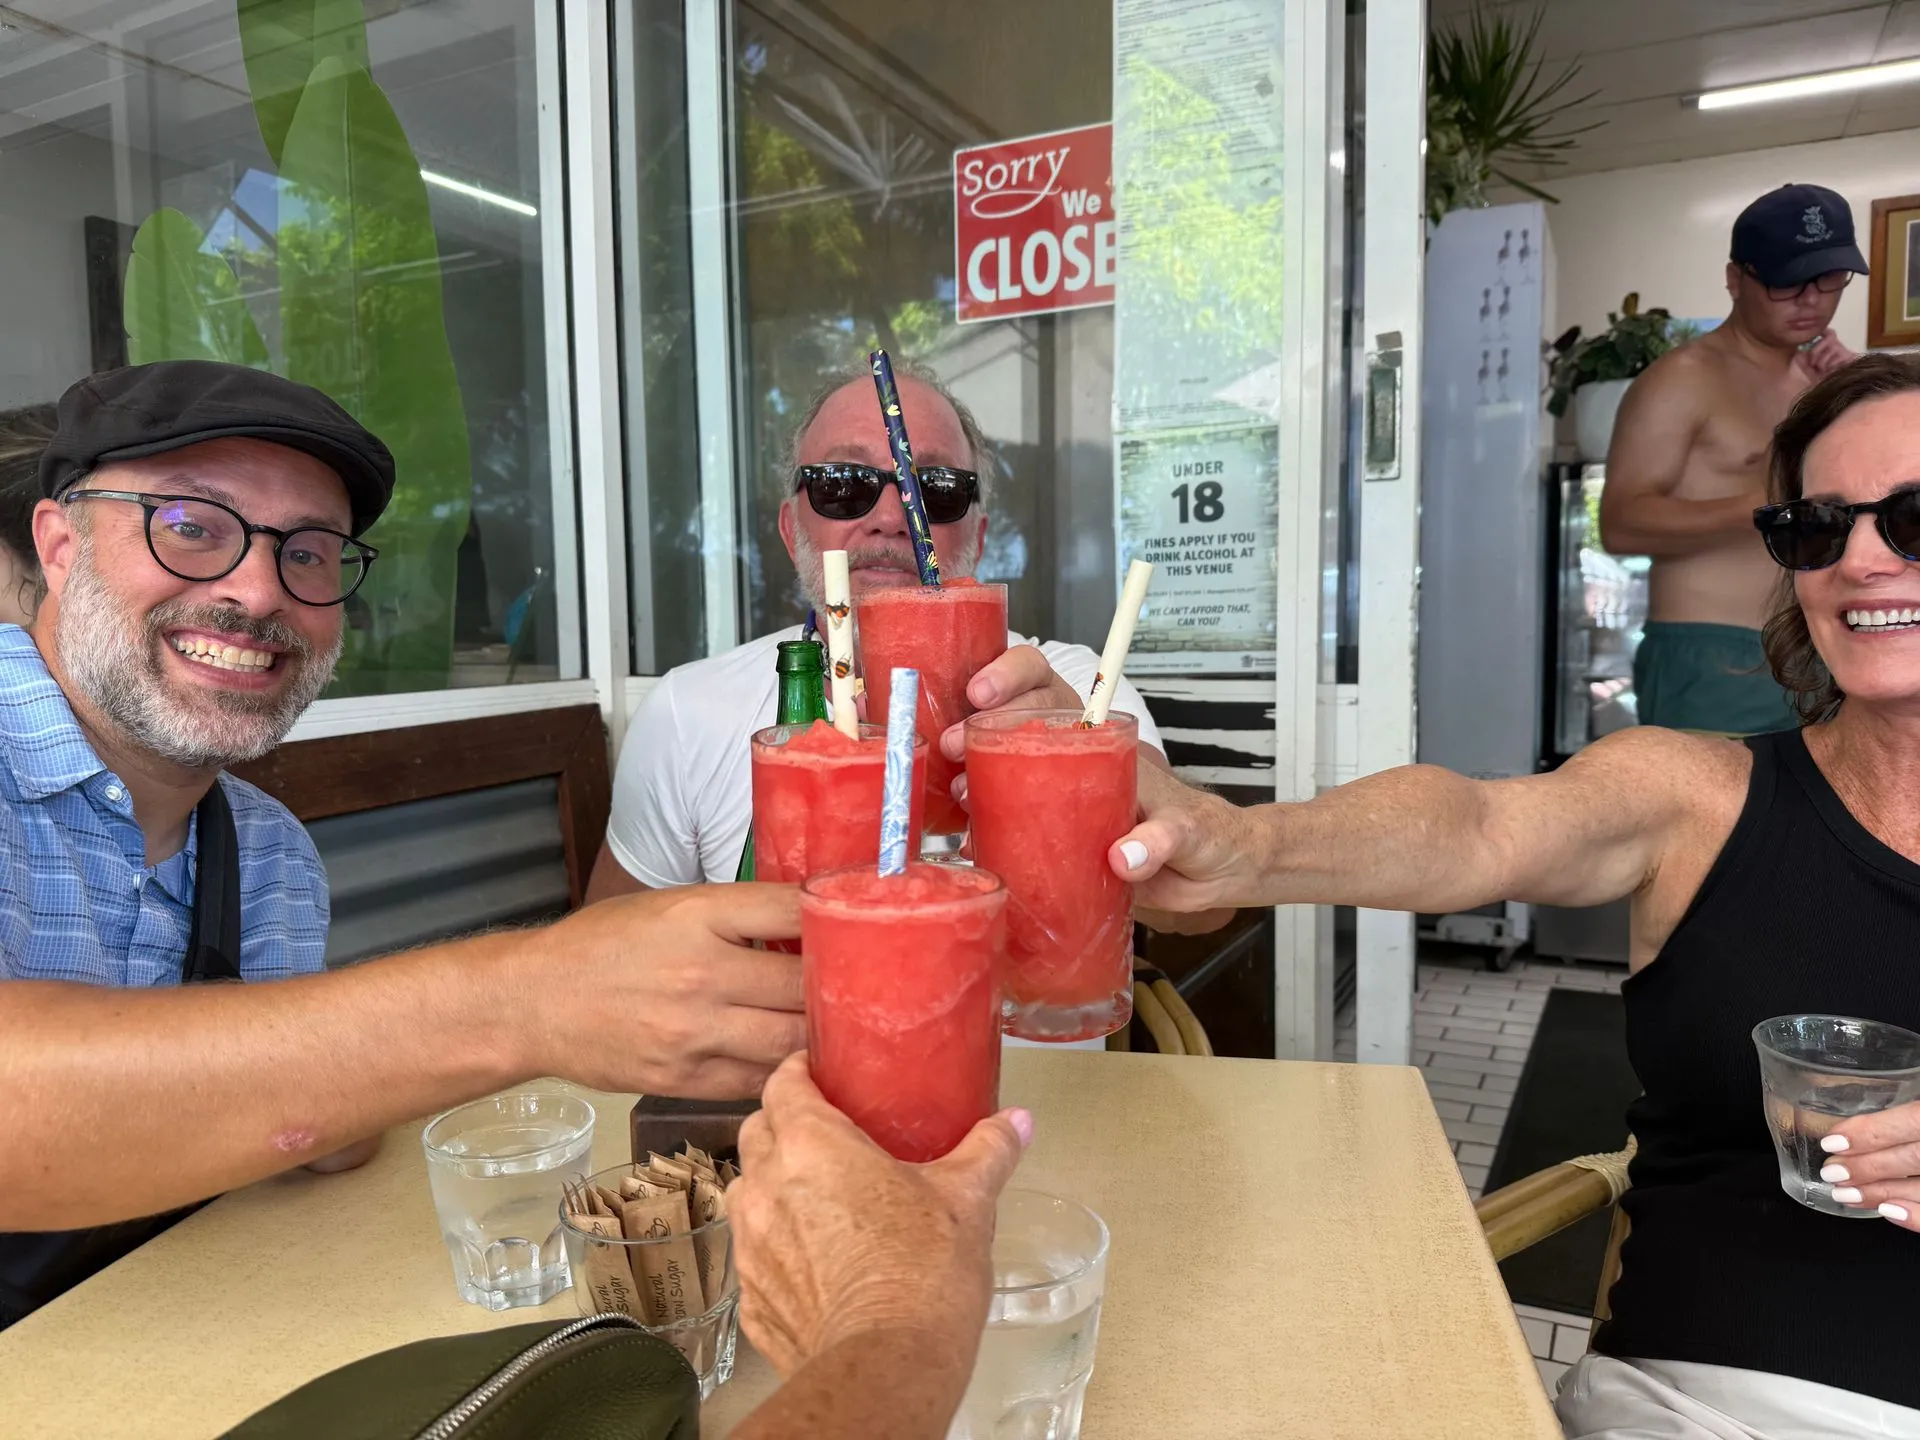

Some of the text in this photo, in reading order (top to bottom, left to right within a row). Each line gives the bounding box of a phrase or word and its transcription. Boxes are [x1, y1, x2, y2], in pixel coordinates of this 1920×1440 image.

[961, 146, 1070, 219] Sorry
[1061, 188, 1101, 218] We
[967, 220, 1115, 303] CLOSE
[1173, 460, 1224, 477] UNDER
[1171, 480, 1225, 524] 18
[1144, 532, 1255, 549] FINES APPLY IF YOU
[1146, 547, 1255, 563] DRINK ALCOHOL AT
[1166, 563, 1234, 576] THIS VENUE
[1149, 608, 1162, 617] WE
[1163, 606, 1189, 616] CAN'T
[1190, 605, 1225, 615] AFFORD
[1177, 616, 1221, 627] CAN YOU?
[667, 1259, 686, 1298] Sugar
[594, 1284, 614, 1315] tural
[647, 1272, 669, 1318] Natural
